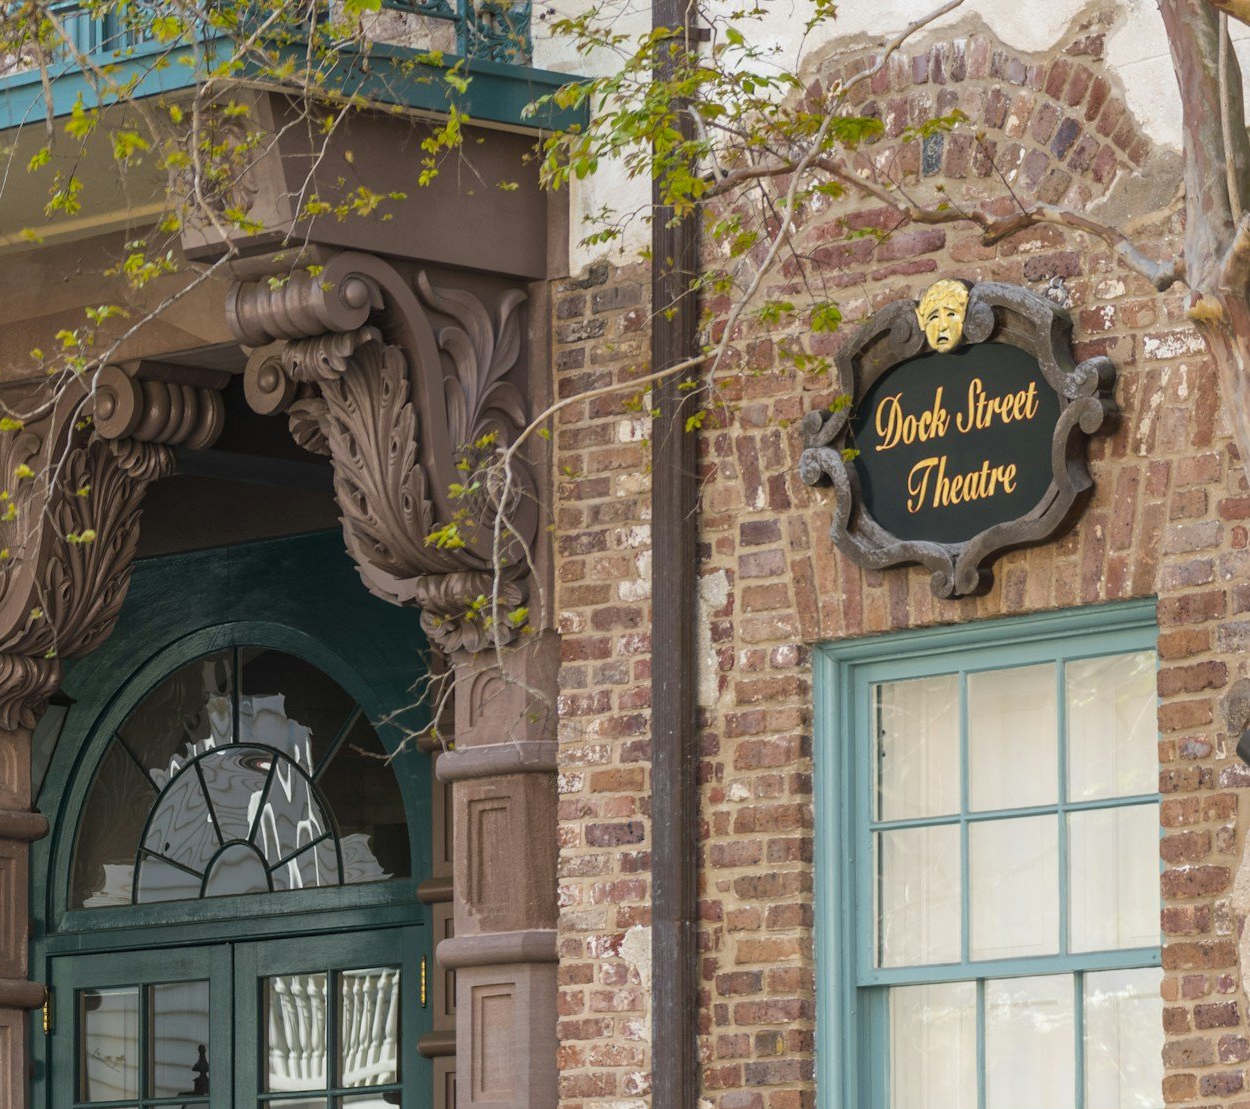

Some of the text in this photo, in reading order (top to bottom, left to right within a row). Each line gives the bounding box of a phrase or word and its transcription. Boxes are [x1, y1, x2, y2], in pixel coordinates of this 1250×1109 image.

[875, 378, 1039, 451] Dock Street
[907, 455, 1017, 514] Theatre
